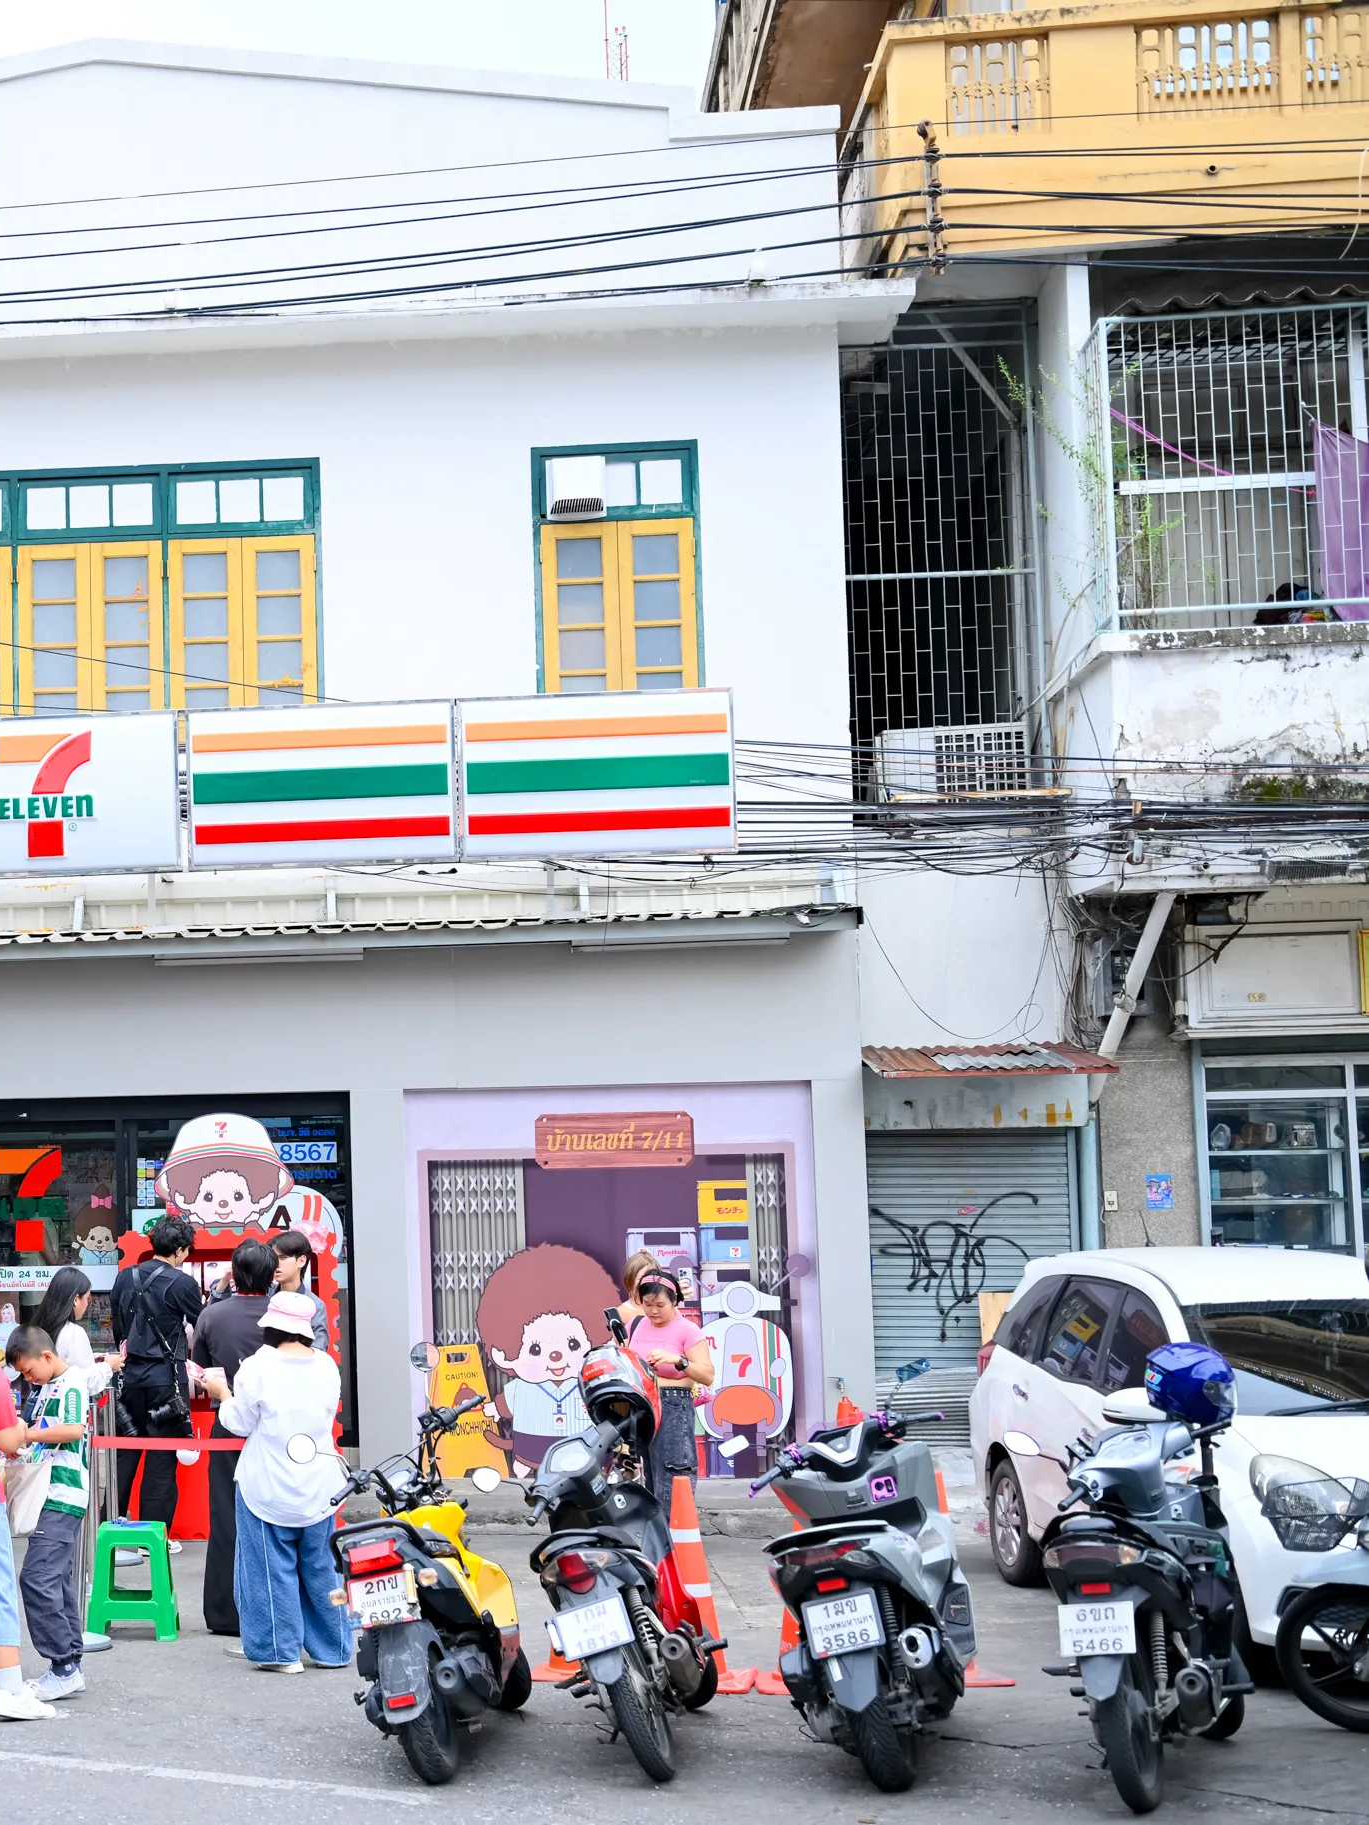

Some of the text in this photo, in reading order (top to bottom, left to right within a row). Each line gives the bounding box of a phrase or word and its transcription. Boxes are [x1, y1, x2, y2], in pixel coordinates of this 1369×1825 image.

[1247, 993, 1267, 1003] 112
[547, 1122, 684, 1151] บ้านเลขที่ 7/11
[280, 1143, 335, 1162] 8567
[18, 1270, 31, 1279] 24
[446, 1371, 479, 1381] CAUTION!
[369, 1607, 402, 1623] 692
[812, 1614, 874, 1636] กรุงเทพมหานคร
[576, 1630, 620, 1653] 1813
[822, 1628, 871, 1651] 3586
[1072, 1637, 1123, 1653] 5466
